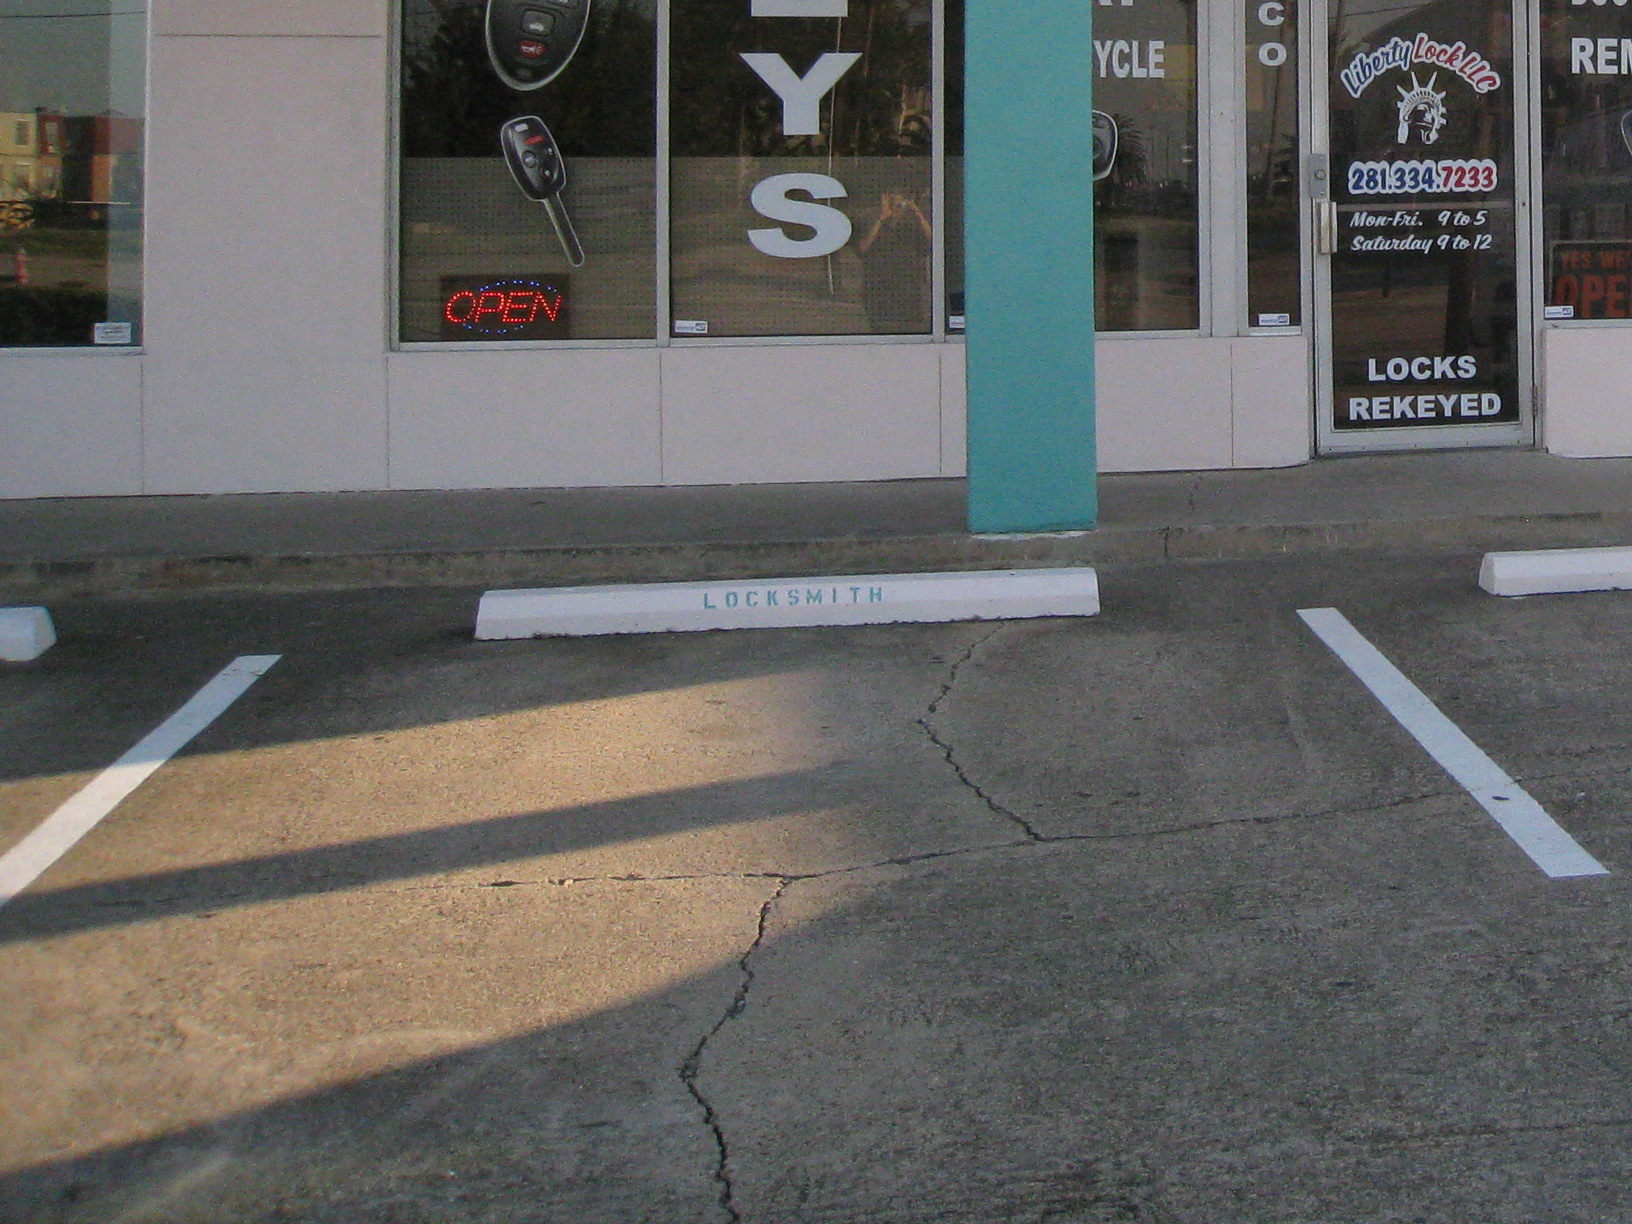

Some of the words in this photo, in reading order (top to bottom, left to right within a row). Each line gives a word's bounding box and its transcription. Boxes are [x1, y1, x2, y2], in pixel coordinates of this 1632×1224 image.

[1350, 164, 1496, 192] 281.334.7233
[1437, 211, 1451, 226] 9
[1453, 211, 1472, 226] to
[1473, 210, 1488, 226] 5
[1351, 234, 1434, 255] Saturday
[1437, 234, 1450, 251] 9
[1452, 234, 1471, 251] to
[1473, 234, 1493, 251] 12
[445, 291, 562, 324] OPEN
[1368, 356, 1477, 382] LOCKS
[1348, 392, 1502, 421] REKEYED
[703, 586, 883, 610] LOCKSMITH
